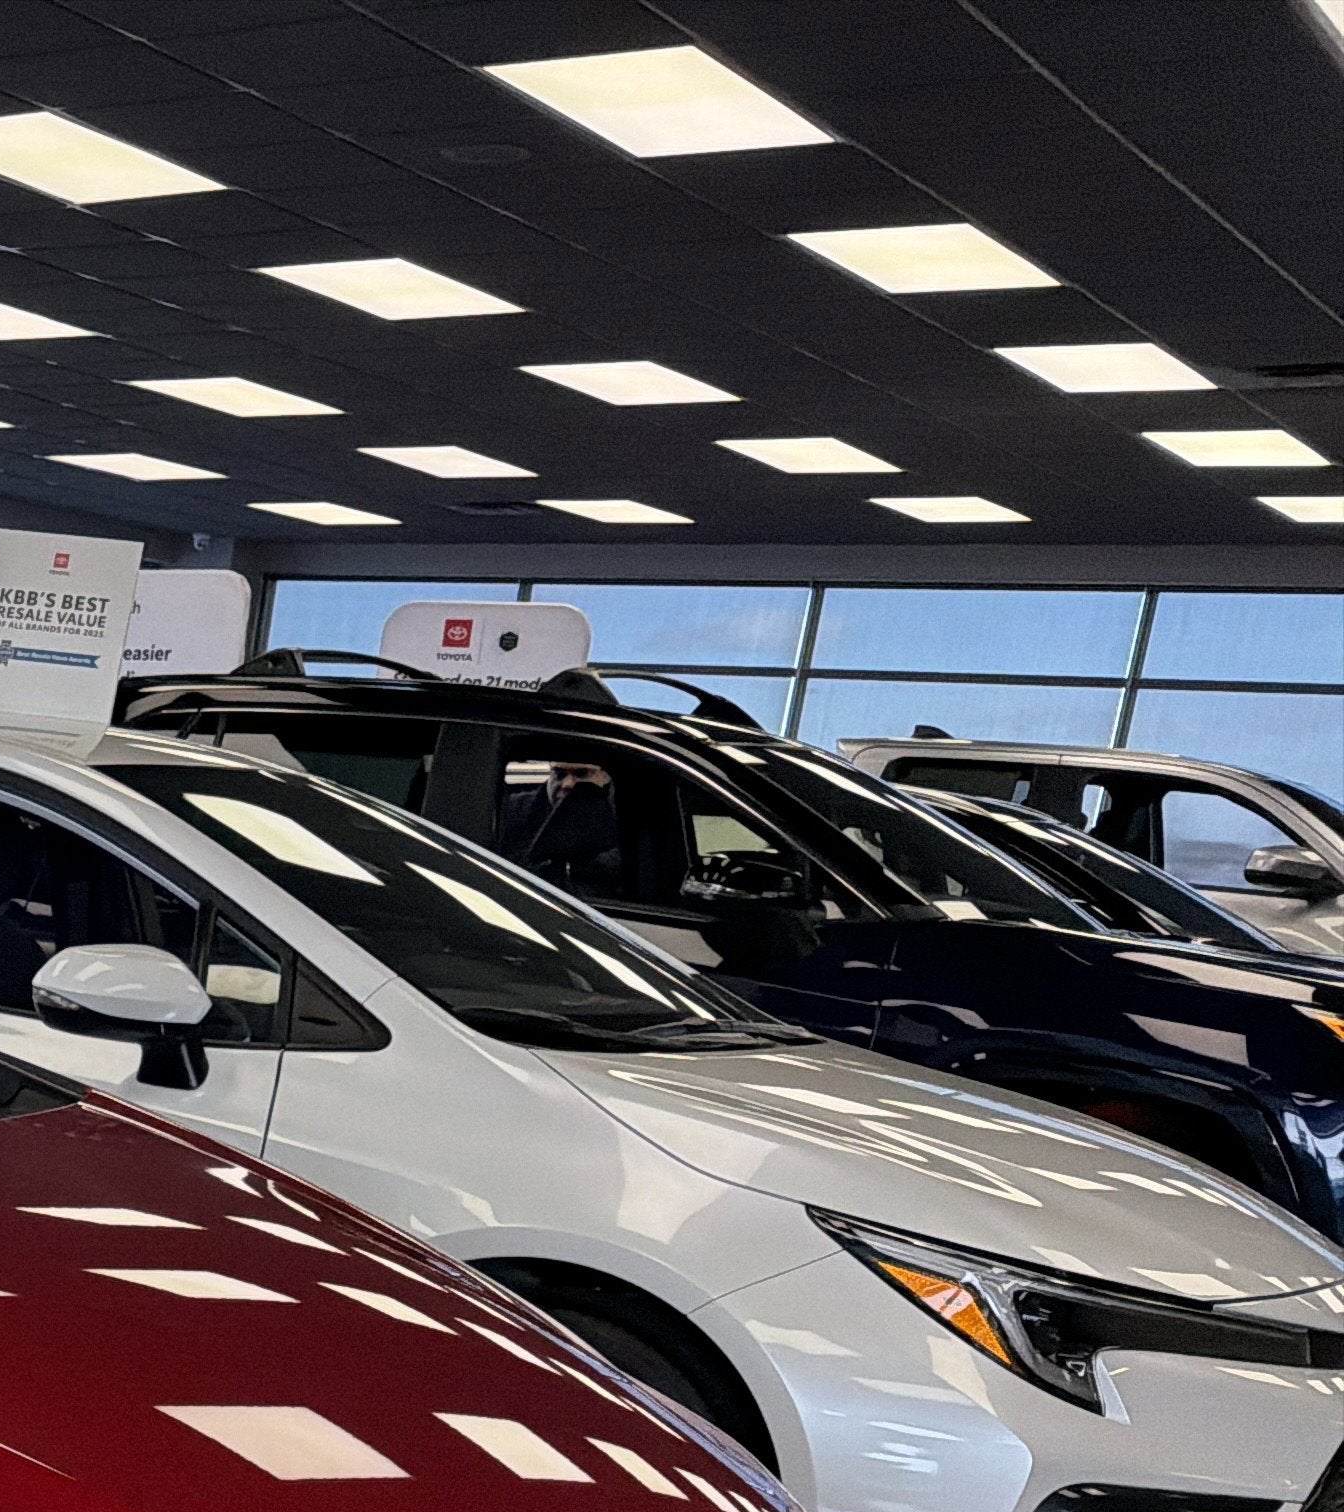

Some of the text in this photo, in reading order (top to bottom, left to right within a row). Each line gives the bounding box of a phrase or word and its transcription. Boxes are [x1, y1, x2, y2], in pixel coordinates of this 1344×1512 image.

[0, 588, 57, 608] KBB'S
[61, 594, 110, 613] BEST
[57, 611, 107, 628] VALUE
[8, 621, 23, 630] ALL
[25, 623, 61, 633] BRANDS
[63, 626, 80, 635] FOR
[123, 644, 172, 661] easier
[436, 652, 472, 662] TOYOTA
[486, 676, 502, 687] 21
